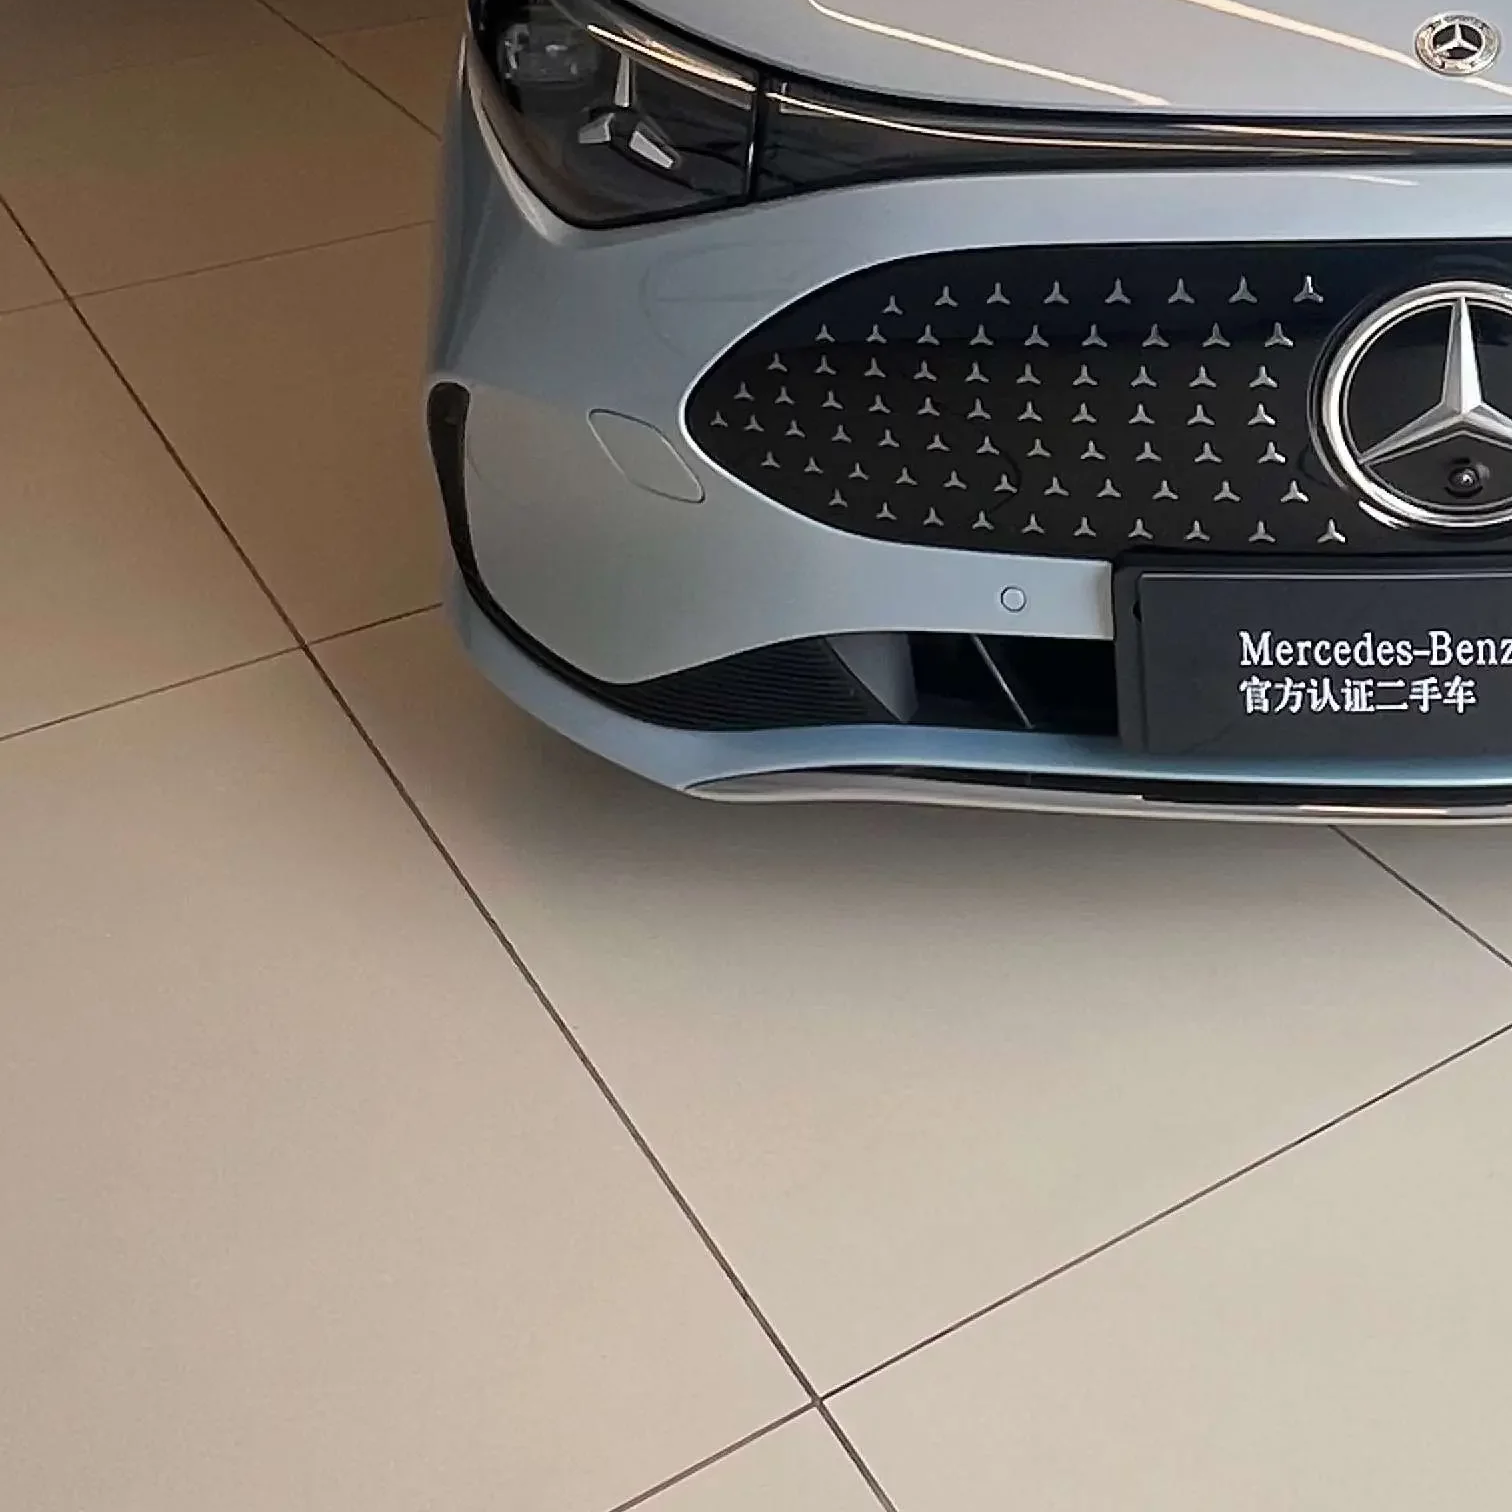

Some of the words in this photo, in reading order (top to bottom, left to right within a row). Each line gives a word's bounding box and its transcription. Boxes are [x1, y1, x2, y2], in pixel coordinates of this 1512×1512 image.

[1239, 675, 1477, 714] 官方认证二手车
